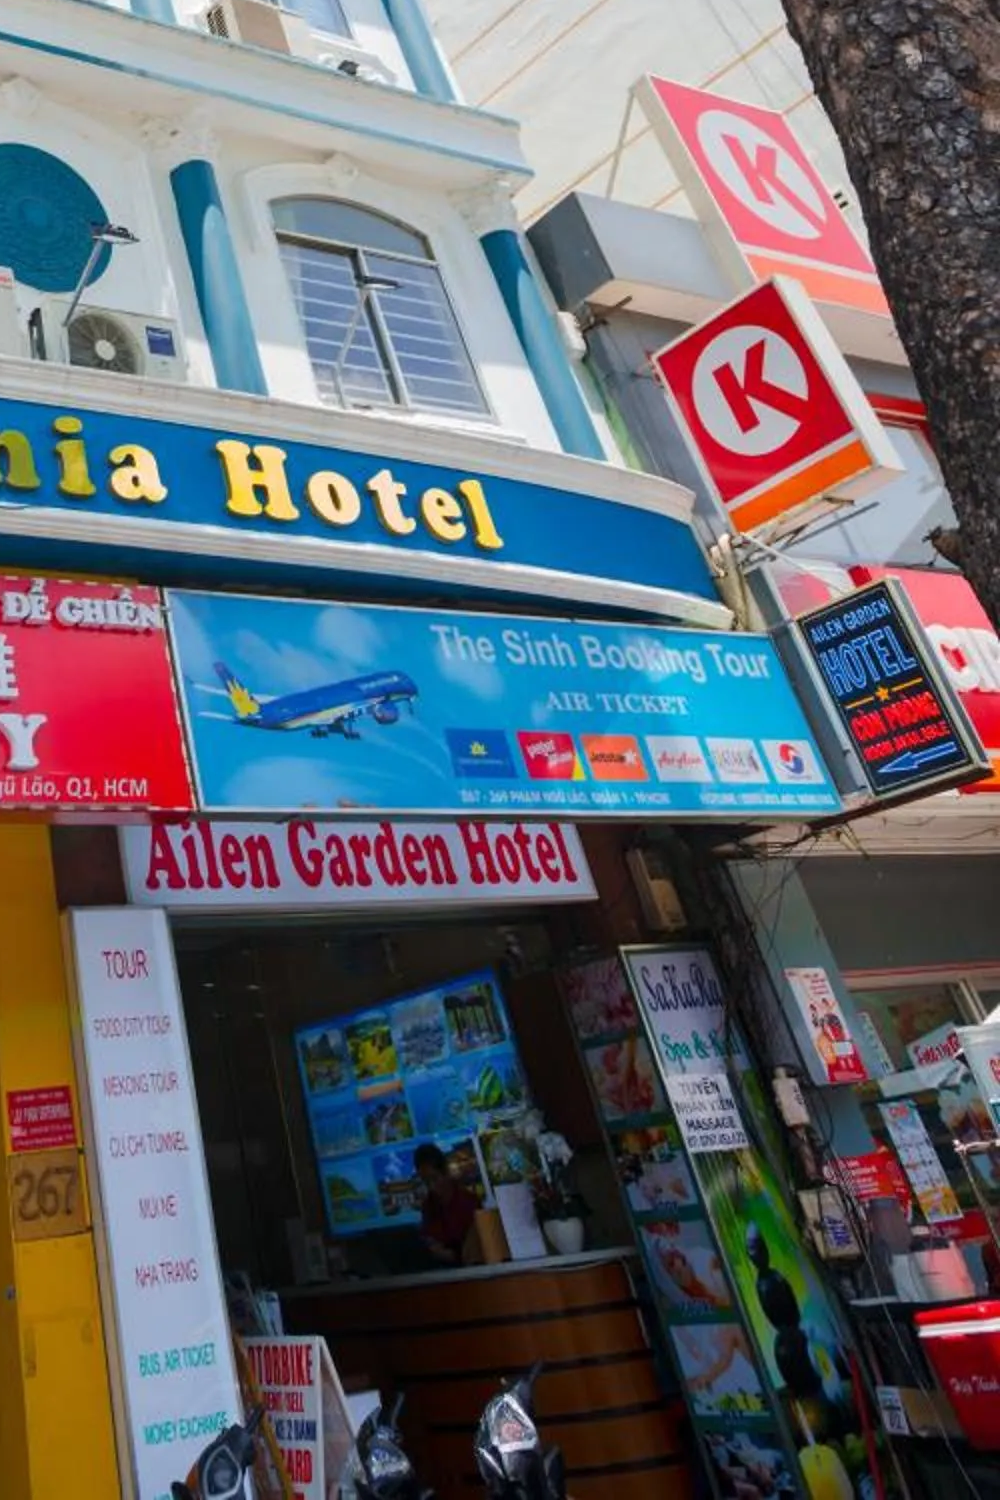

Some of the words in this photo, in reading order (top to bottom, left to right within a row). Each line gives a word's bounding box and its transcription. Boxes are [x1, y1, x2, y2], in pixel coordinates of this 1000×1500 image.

[721, 133, 827, 236] K
[711, 337, 807, 437] K
[215, 438, 504, 550] Hotel
[809, 621, 845, 646] AILEN
[842, 597, 893, 630] GARDEN
[429, 624, 496, 663] The
[502, 629, 577, 668] Sinh
[580, 634, 706, 684] Booking
[704, 643, 771, 679] Tour
[819, 625, 918, 697] HOTEL
[546, 690, 591, 713] AIR
[595, 692, 689, 716] TICKET
[21, 777, 61, 801] Lão,
[65, 777, 99, 801] Q1,
[104, 777, 149, 798] HCM
[145, 820, 281, 890] Ailen
[287, 820, 458, 888] Garden
[456, 821, 578, 886] Hotel
[102, 949, 150, 979] TOUR
[145, 1014, 171, 1035] TOUR
[660, 1032, 690, 1075] Spa
[103, 1073, 150, 1097] MEKONG
[149, 1071, 179, 1093] TOUR
[147, 1130, 190, 1153] TUNNEL
[13, 1165, 76, 1222] 267
[134, 1265, 160, 1289] NHA
[158, 1258, 200, 1285] TRANG
[182, 1342, 216, 1367] TICKET
[246, 1344, 314, 1387] OTORBIKE
[143, 1418, 176, 1445] MONEY
[178, 1411, 229, 1441] EXCHANGE
